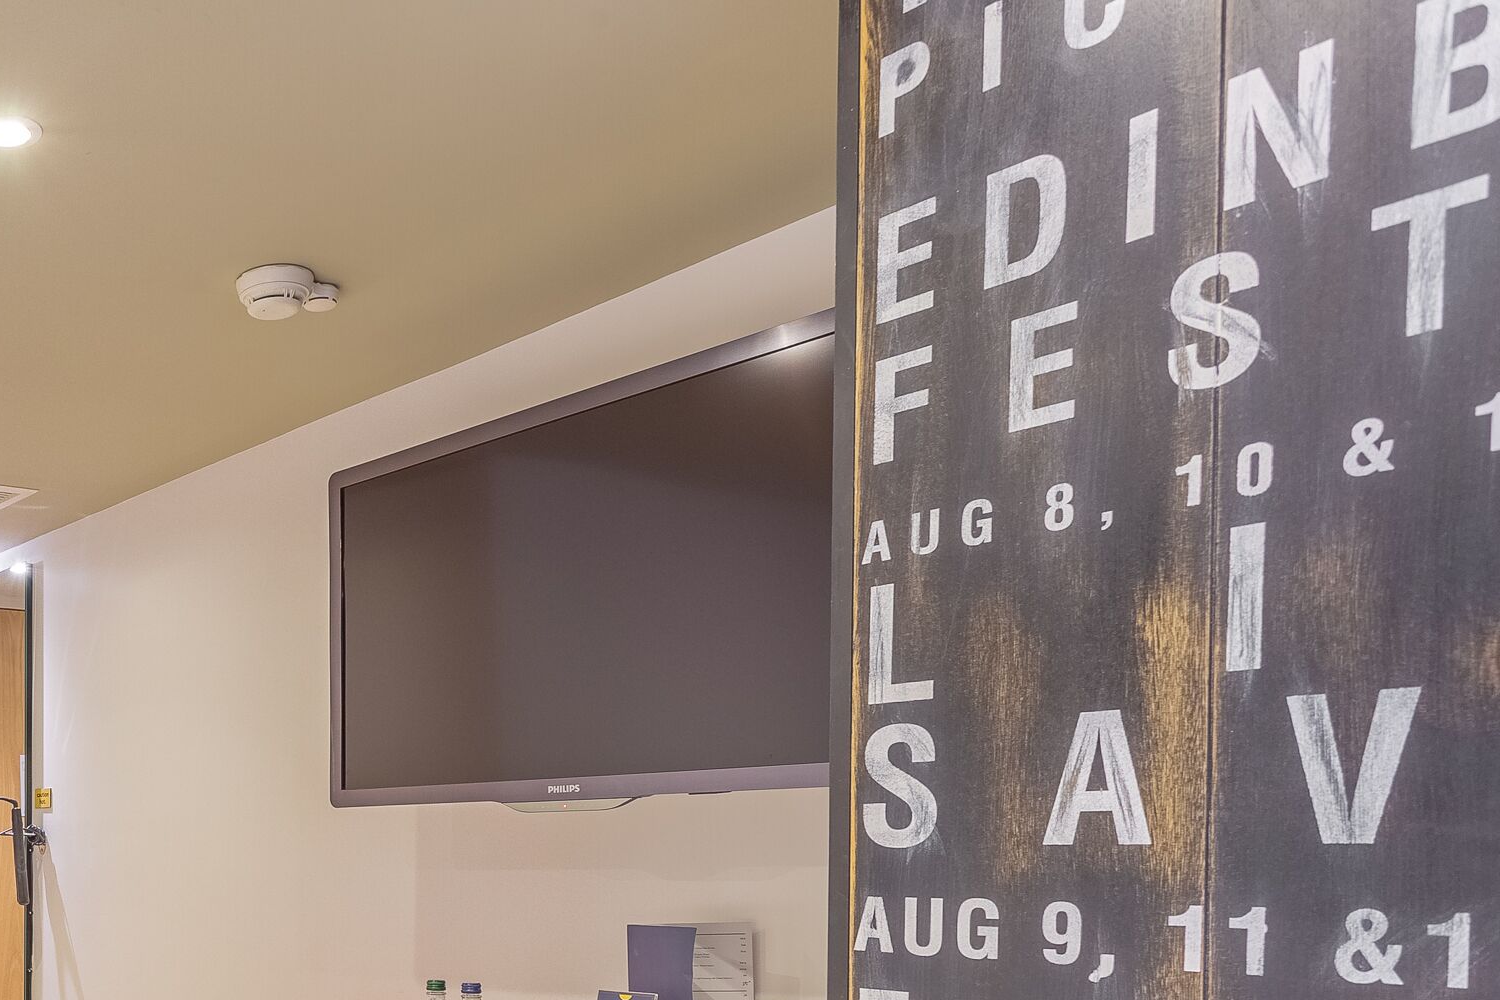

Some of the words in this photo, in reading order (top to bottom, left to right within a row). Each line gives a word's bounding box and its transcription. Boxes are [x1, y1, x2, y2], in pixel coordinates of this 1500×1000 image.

[873, 174, 1491, 465] FEST
[862, 499, 993, 565] AUG
[1044, 483, 1114, 532] 8,
[1175, 442, 1274, 507] 10
[1343, 417, 1395, 477] &
[547, 784, 580, 793] PHILIPS
[862, 686, 1422, 849] SAV
[854, 896, 999, 960] AUG
[1042, 902, 1115, 983] 9,
[1167, 905, 1268, 977] 11
